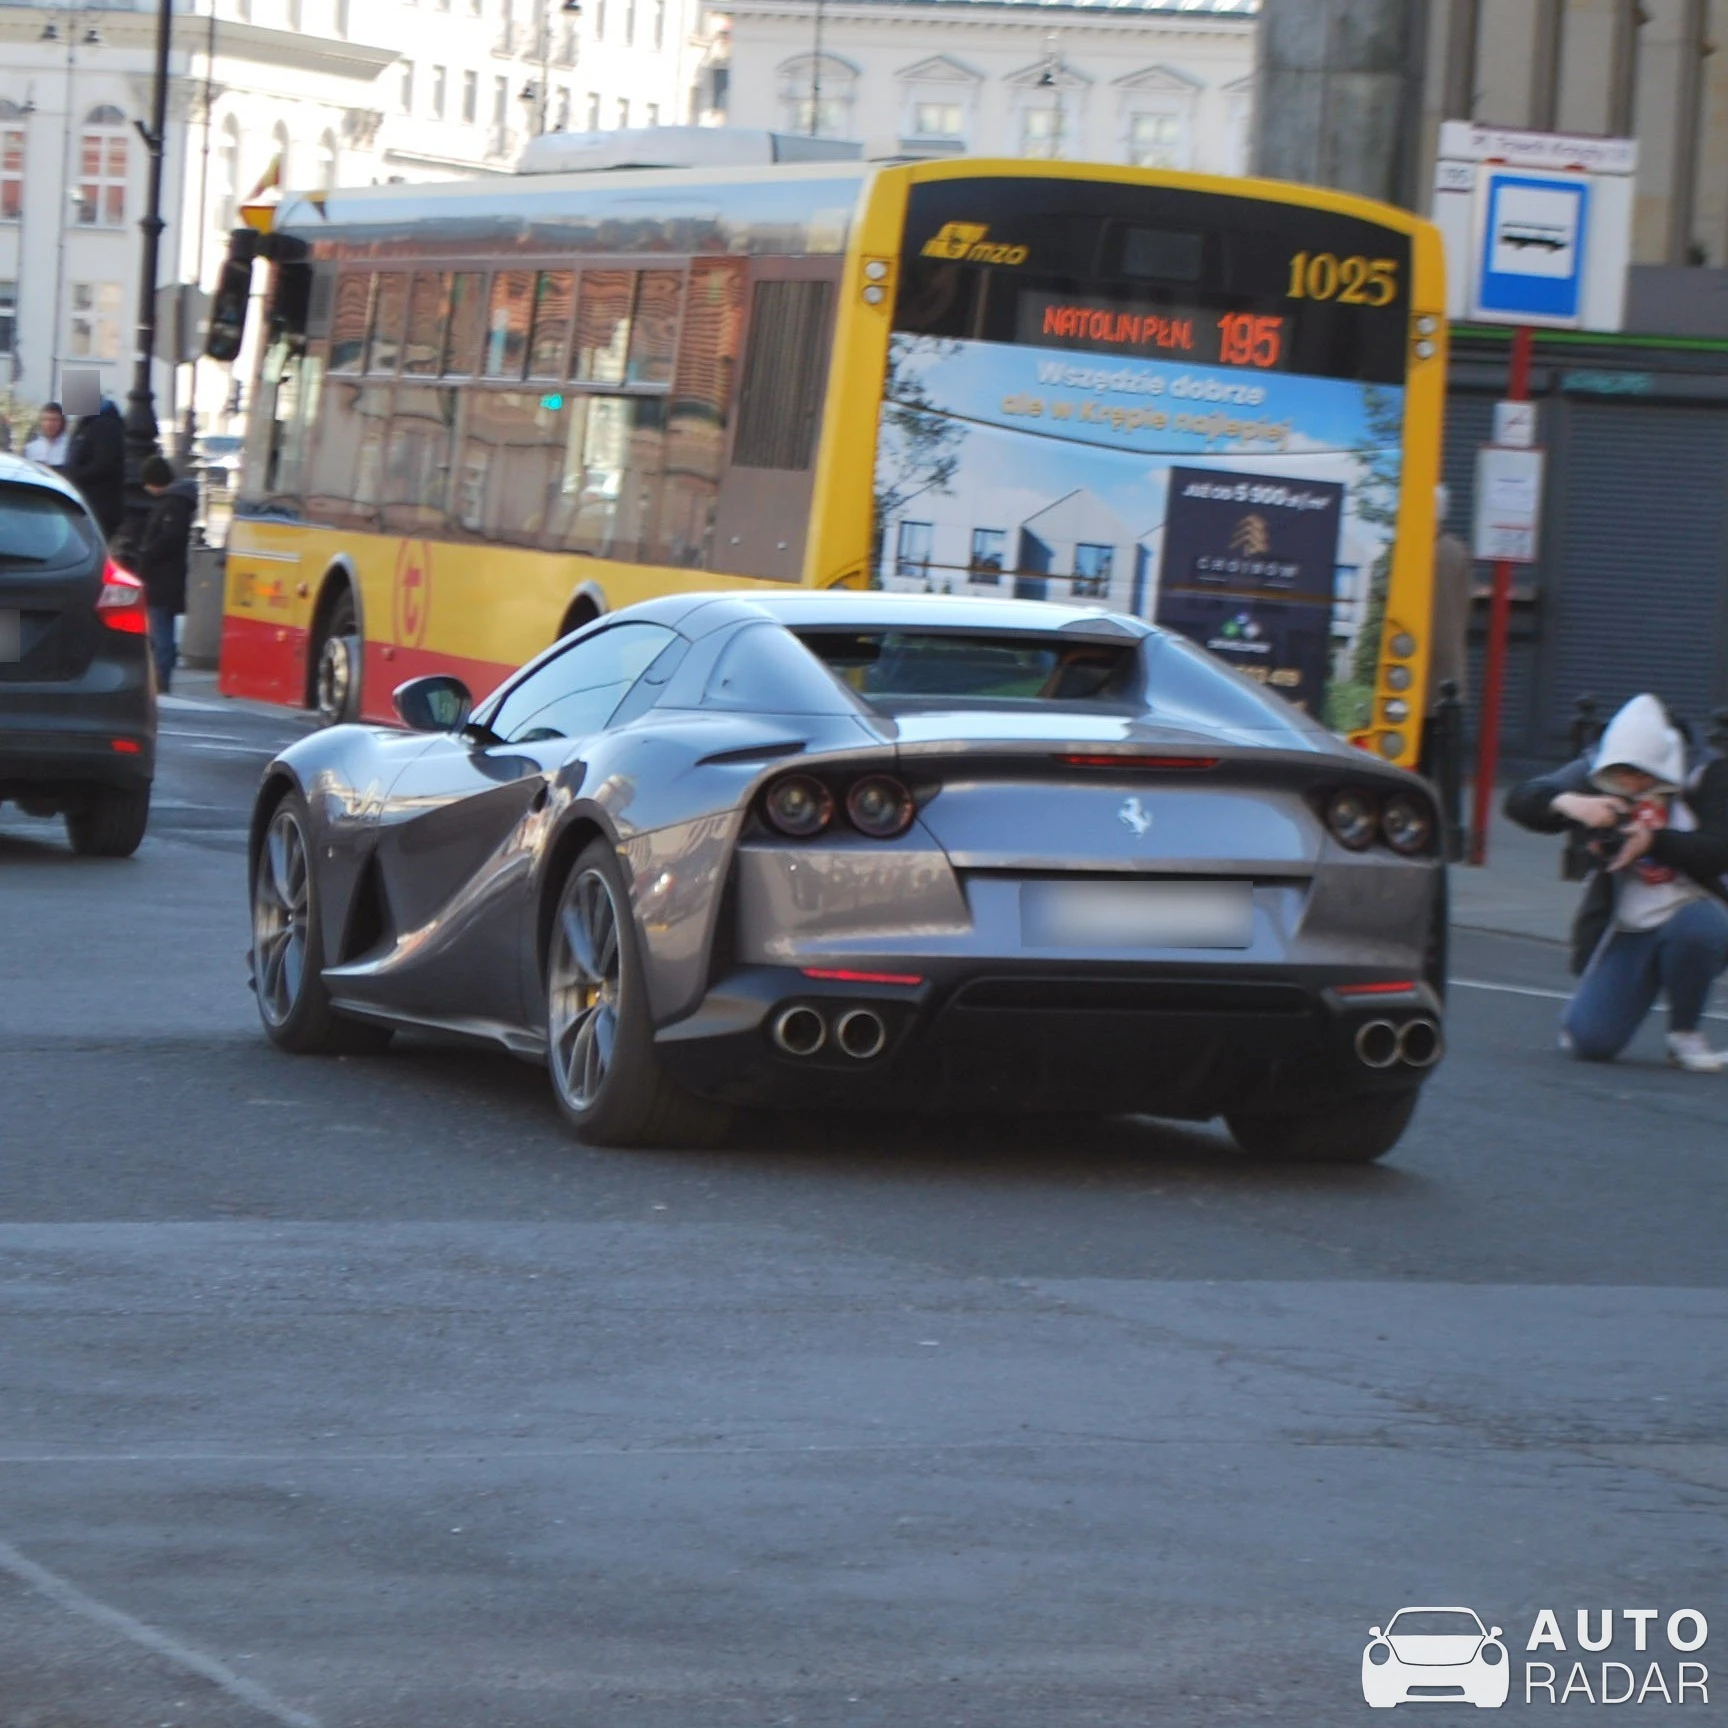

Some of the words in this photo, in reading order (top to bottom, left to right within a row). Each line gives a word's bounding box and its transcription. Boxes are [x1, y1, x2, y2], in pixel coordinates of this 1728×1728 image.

[1287, 251, 1398, 307] 1025
[1042, 304, 1141, 345] NATOLIN
[1216, 310, 1284, 369] 195
[1003, 391, 1044, 418] ale
[1052, 402, 1074, 421] w
[1036, 360, 1166, 395] Wszędzie
[1169, 373, 1267, 407] dobrze
